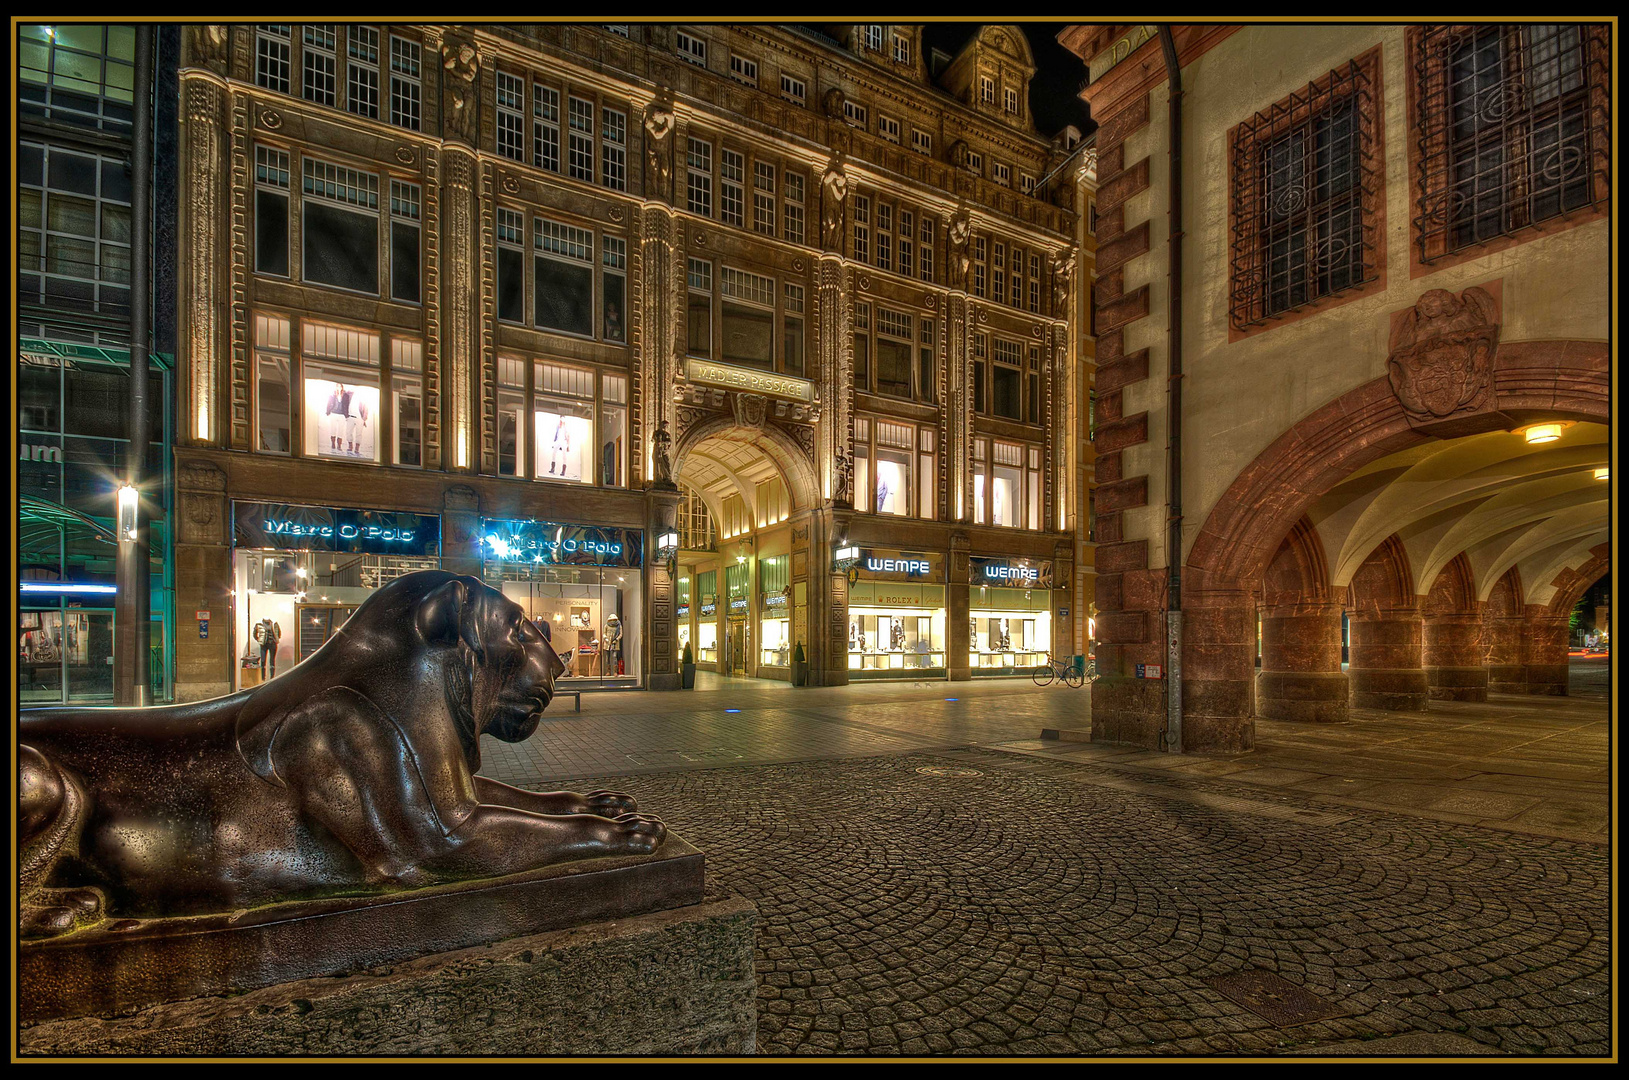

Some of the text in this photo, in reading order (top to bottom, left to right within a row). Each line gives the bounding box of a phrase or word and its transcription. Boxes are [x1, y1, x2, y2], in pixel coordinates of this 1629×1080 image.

[751, 376, 802, 396] PASSAGE
[264, 519, 333, 537] Marc
[868, 558, 930, 573] WEMPE
[986, 566, 1038, 579] WEMPE
[766, 596, 786, 605] WEMPE
[886, 596, 912, 604] ROLEX
